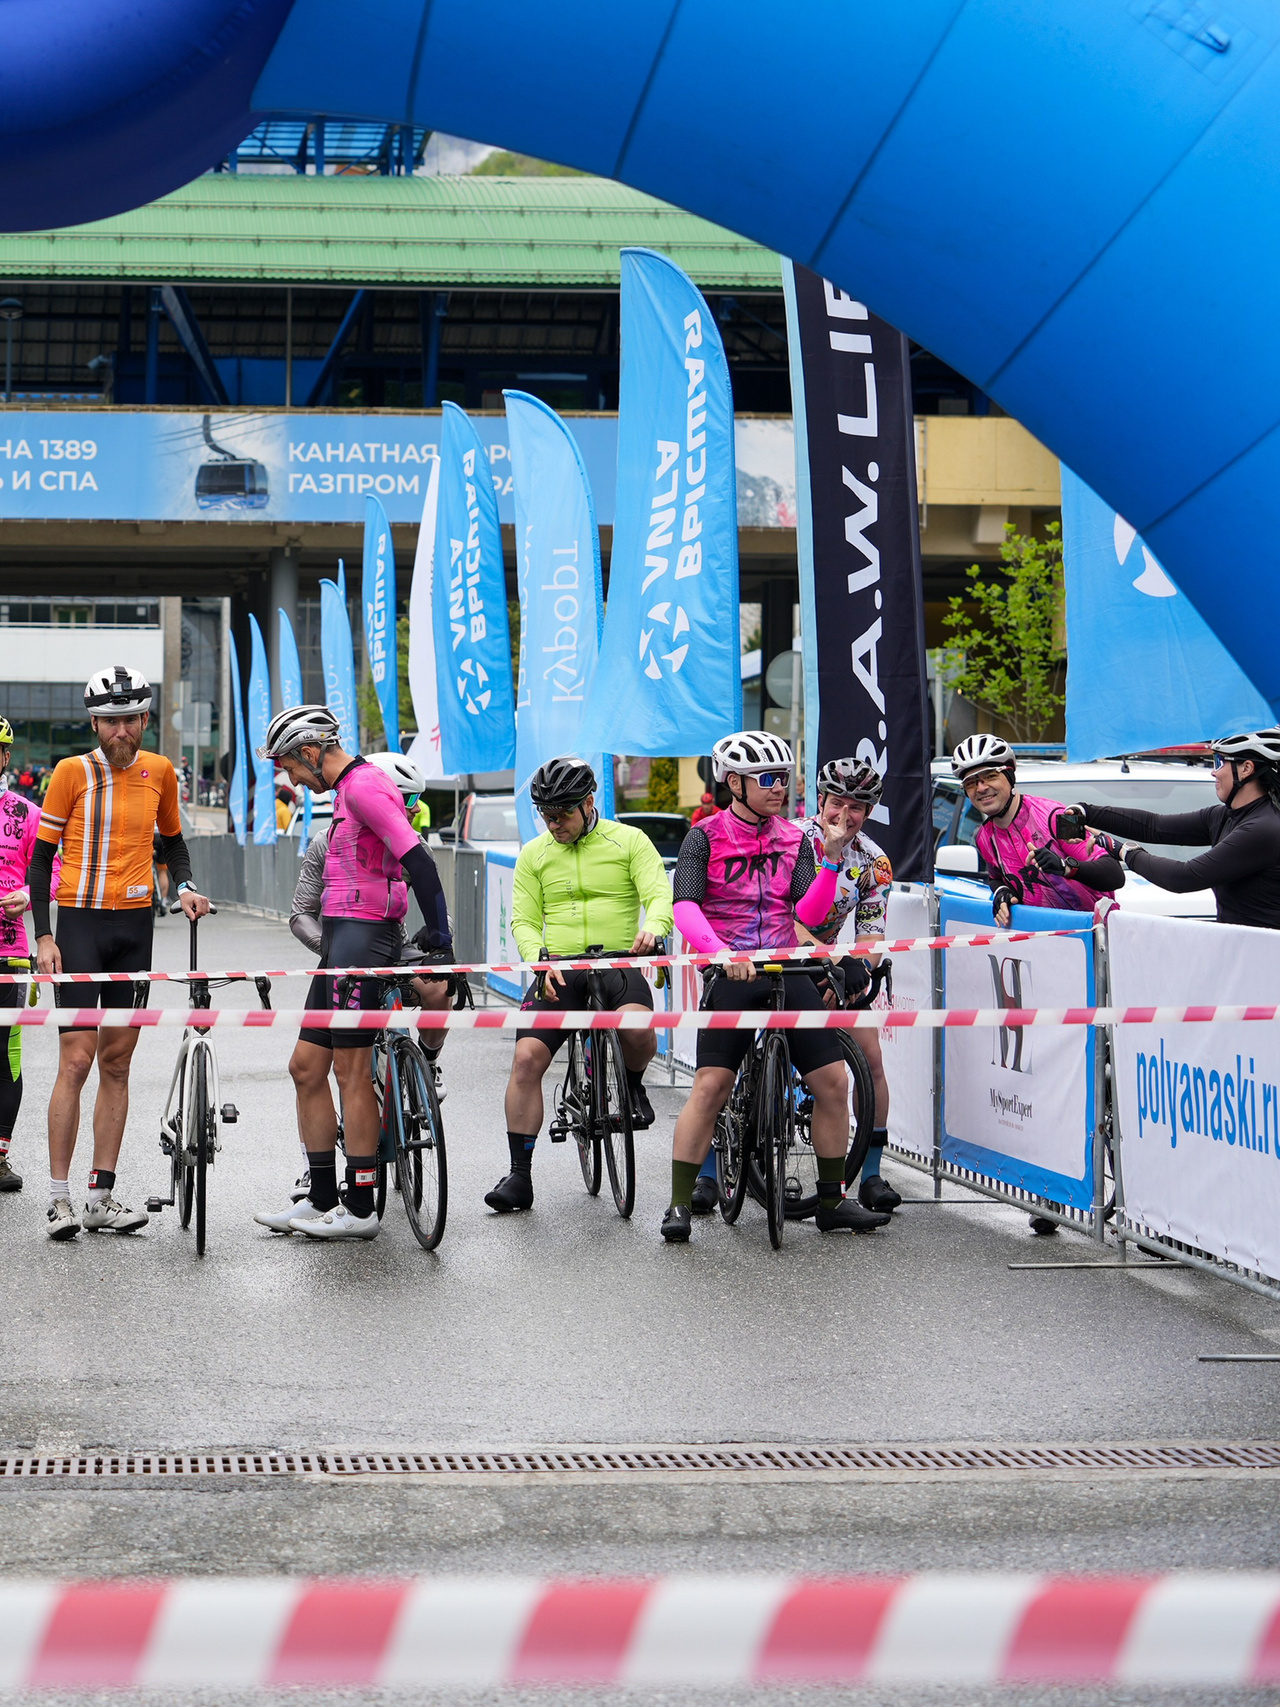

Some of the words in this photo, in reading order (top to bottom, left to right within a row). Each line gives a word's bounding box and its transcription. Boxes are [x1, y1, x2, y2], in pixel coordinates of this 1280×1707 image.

[822, 279, 879, 438] LIF
[40, 438, 98, 461] 1389
[288, 442, 438, 464] КАНАТНАЯ
[12, 471, 32, 491] И
[39, 470, 99, 492] СПА
[288, 473, 420, 495] ГАЗПРОМ
[724, 850, 789, 885] DRT
[989, 1087, 1033, 1121] MySportExpert
